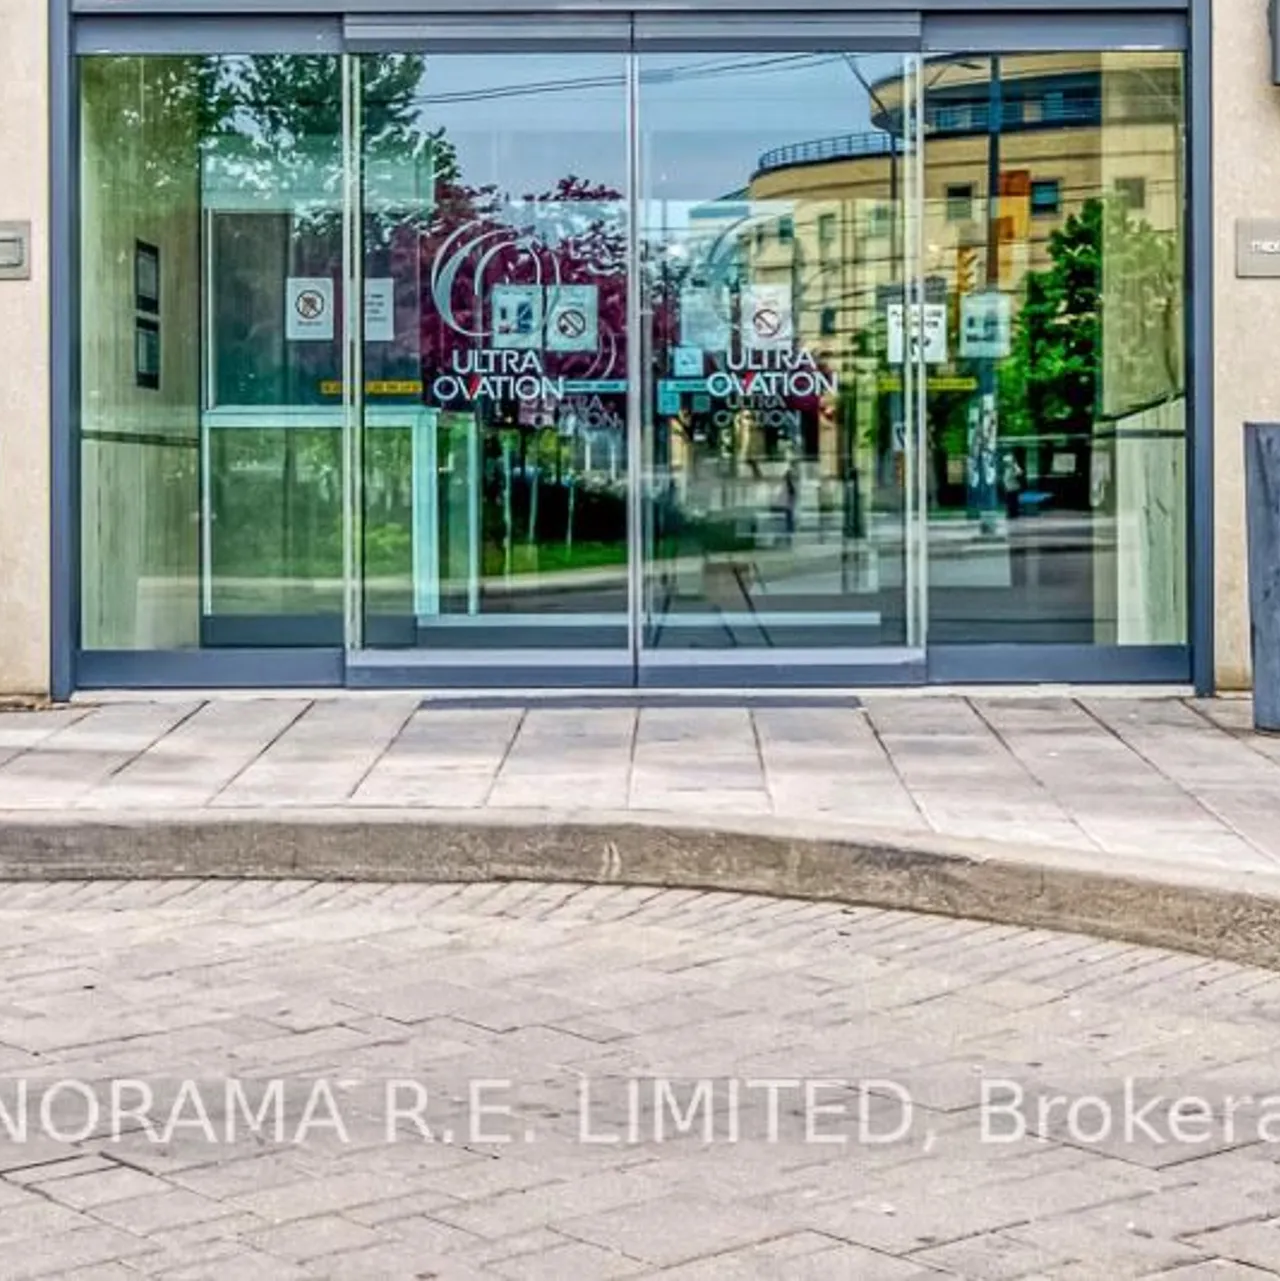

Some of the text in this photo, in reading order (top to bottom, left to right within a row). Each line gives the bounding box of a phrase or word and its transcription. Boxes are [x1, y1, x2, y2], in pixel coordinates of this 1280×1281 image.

[452, 349, 544, 373] ULTRA
[726, 348, 817, 370] ULTRA
[433, 375, 565, 401] OVATION
[707, 372, 839, 397] OVATION
